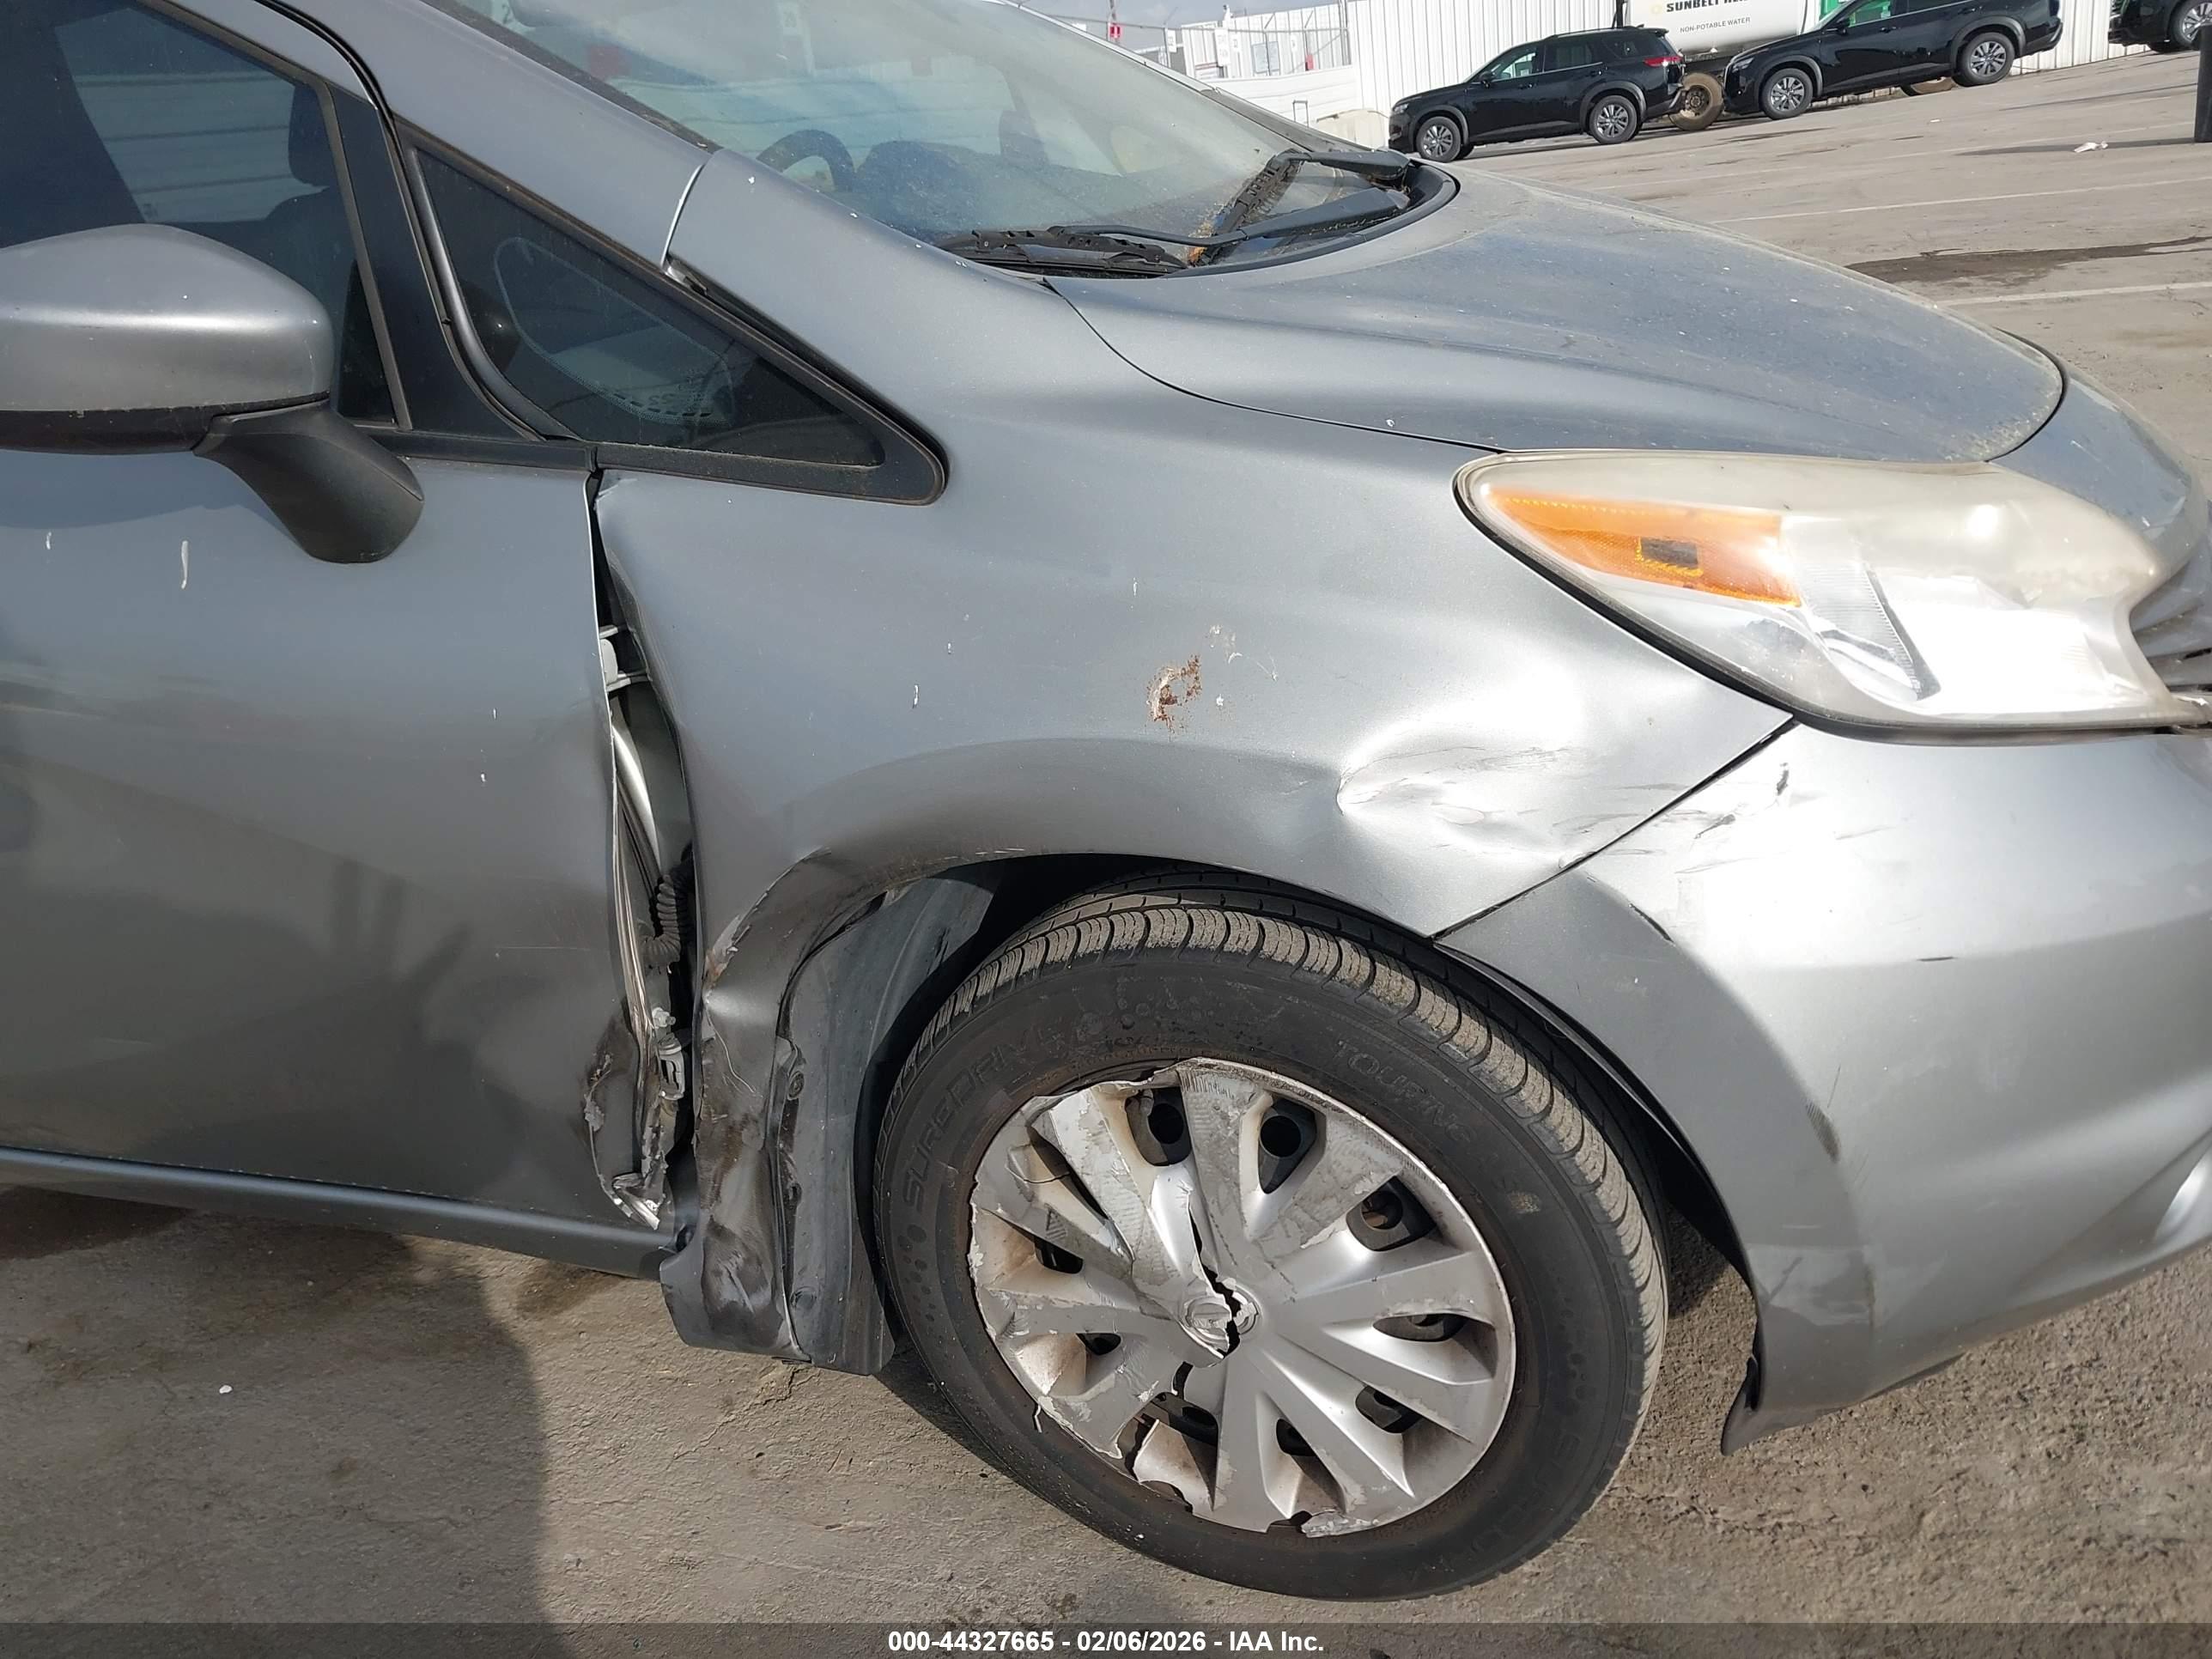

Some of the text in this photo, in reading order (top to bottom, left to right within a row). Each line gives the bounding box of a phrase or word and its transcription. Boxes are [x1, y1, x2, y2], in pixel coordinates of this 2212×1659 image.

[1680, 16, 1751, 33] NON-POTABLE WATER
[1333, 1040, 1479, 1143] TOURING
